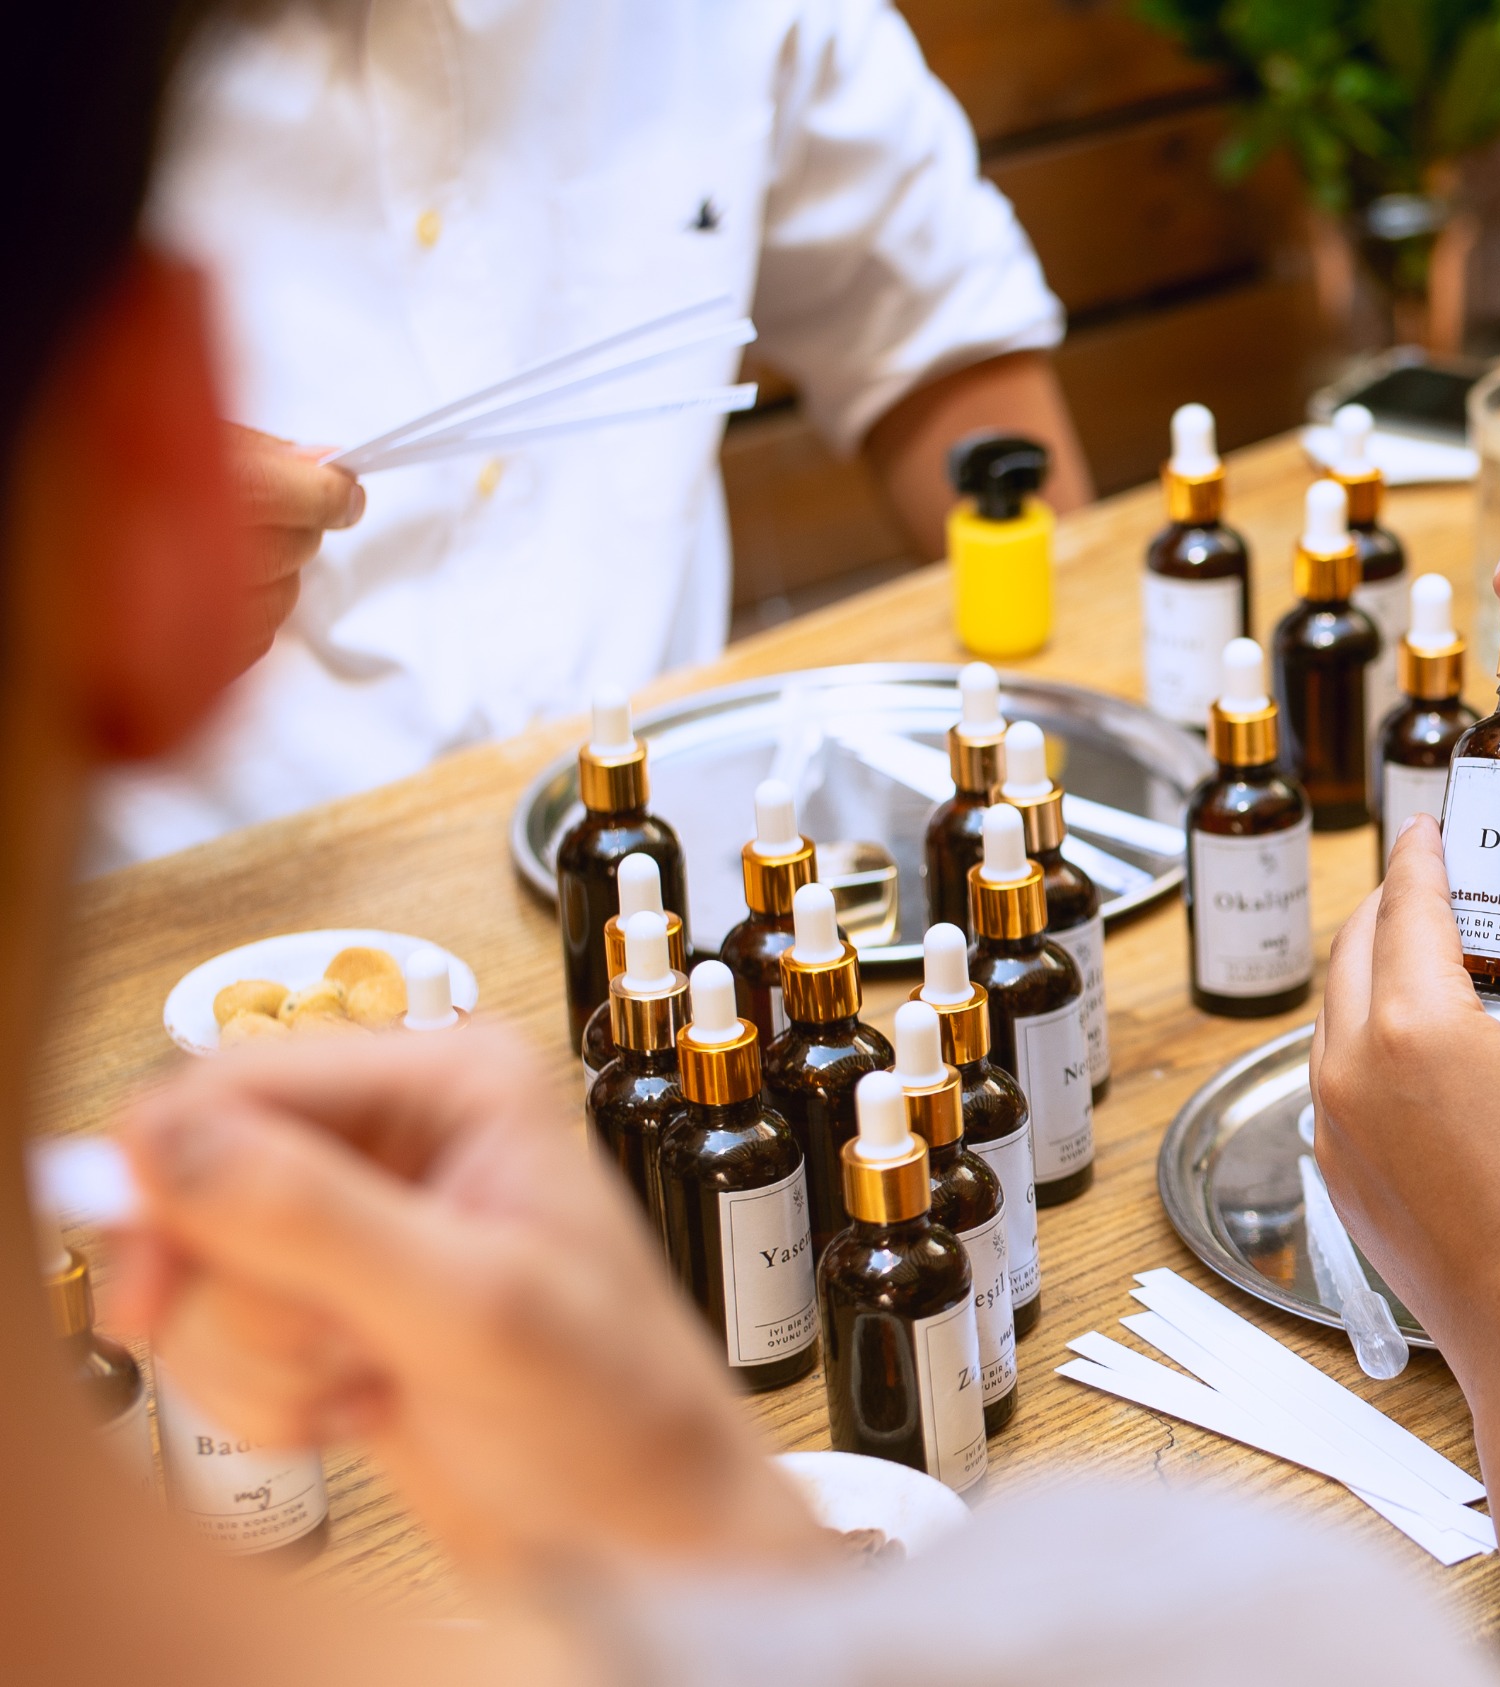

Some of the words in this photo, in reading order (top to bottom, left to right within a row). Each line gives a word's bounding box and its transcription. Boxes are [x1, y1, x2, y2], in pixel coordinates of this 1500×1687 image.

[1456, 915, 1470, 925] İYİ
[1475, 918, 1494, 928] BİR
[1460, 929, 1490, 939] YUNU
[974, 1270, 1005, 1309] eşil
[769, 1326, 783, 1338] İYİ
[788, 1319, 802, 1332] BİR
[768, 1330, 801, 1348] OYUNU
[989, 1364, 1003, 1379] BİR
[982, 1374, 1003, 1391] UNU
